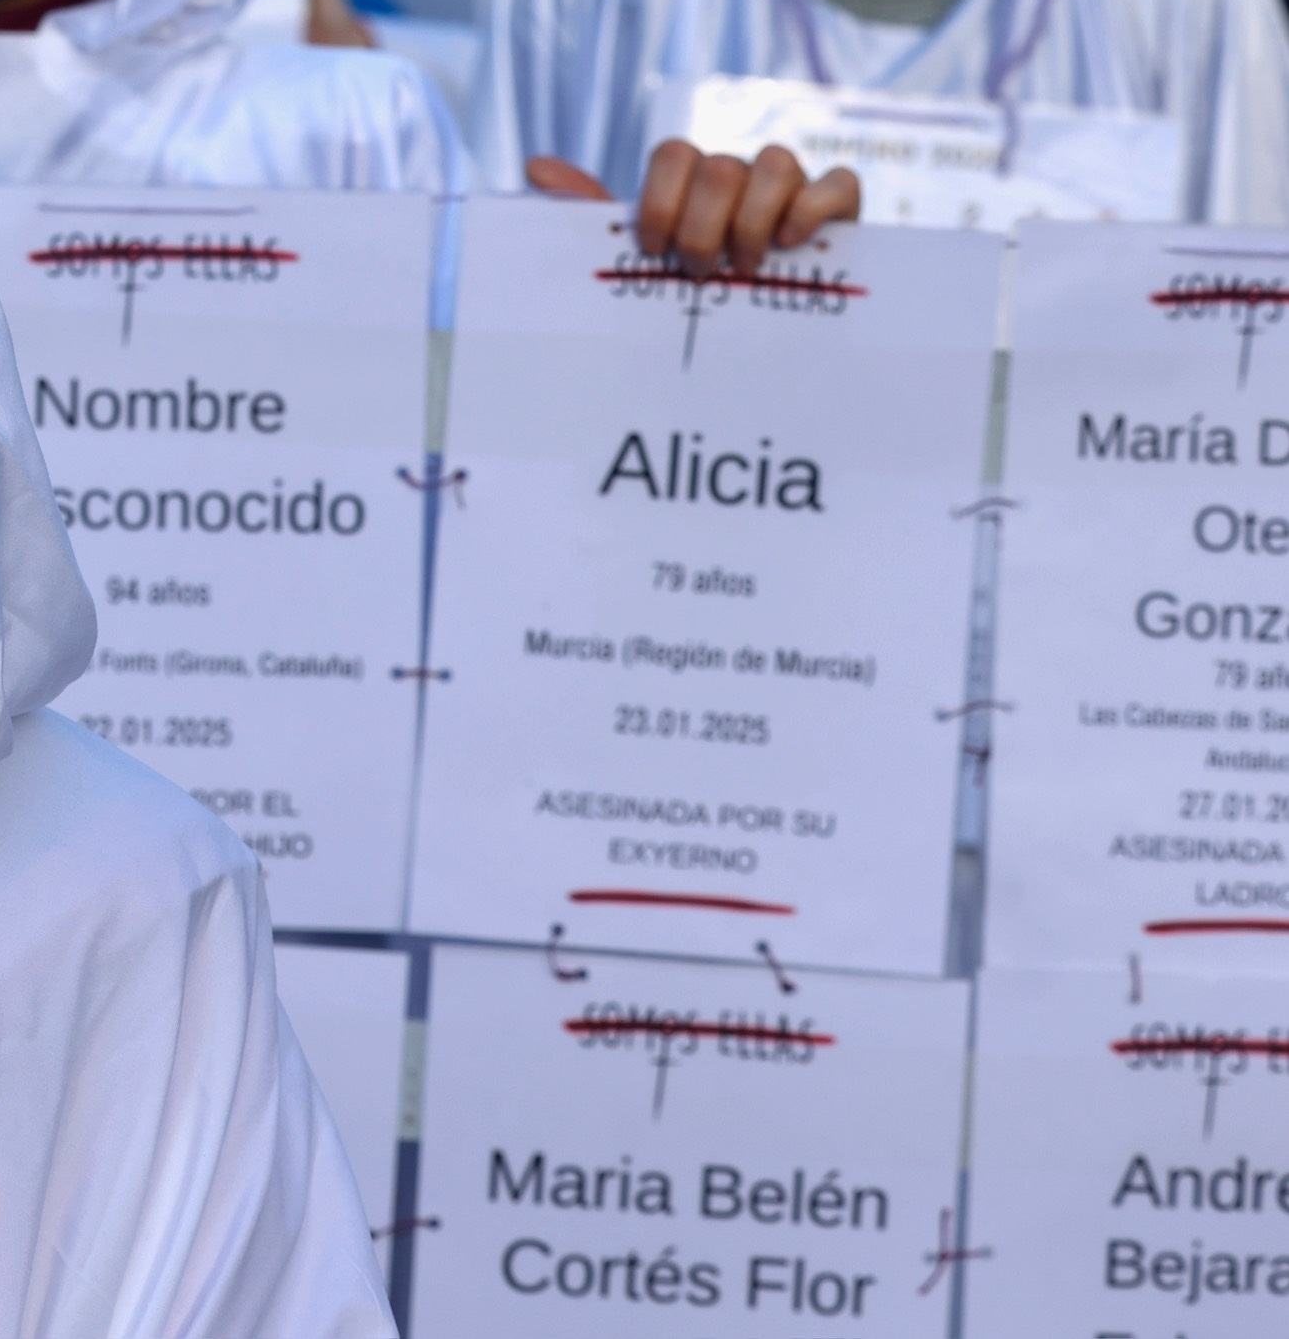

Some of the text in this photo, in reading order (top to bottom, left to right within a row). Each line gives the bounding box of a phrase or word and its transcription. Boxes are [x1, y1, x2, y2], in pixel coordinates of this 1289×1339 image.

[33, 373, 291, 436] Nombre
[1078, 412, 1237, 465] María
[598, 431, 824, 513] Alicia
[106, 576, 211, 607] 94 años
[653, 561, 756, 598] 79 años
[1134, 590, 1289, 644] Gonz
[524, 629, 876, 685] Murcia (Región de Murcia)
[1216, 659, 1248, 688] 79
[614, 704, 771, 746] 23.01.2025
[1079, 705, 1119, 726] Las
[1123, 703, 1219, 730] Cabezas
[1225, 710, 1253, 730] de
[262, 791, 298, 818] EL
[535, 790, 837, 839] ASESINADA POR SU
[608, 836, 758, 875] EXYERNO
[1109, 835, 1285, 865] ASESINADA
[487, 1148, 889, 1231] Maria Belén
[500, 1237, 876, 1318] Cortés Flor
